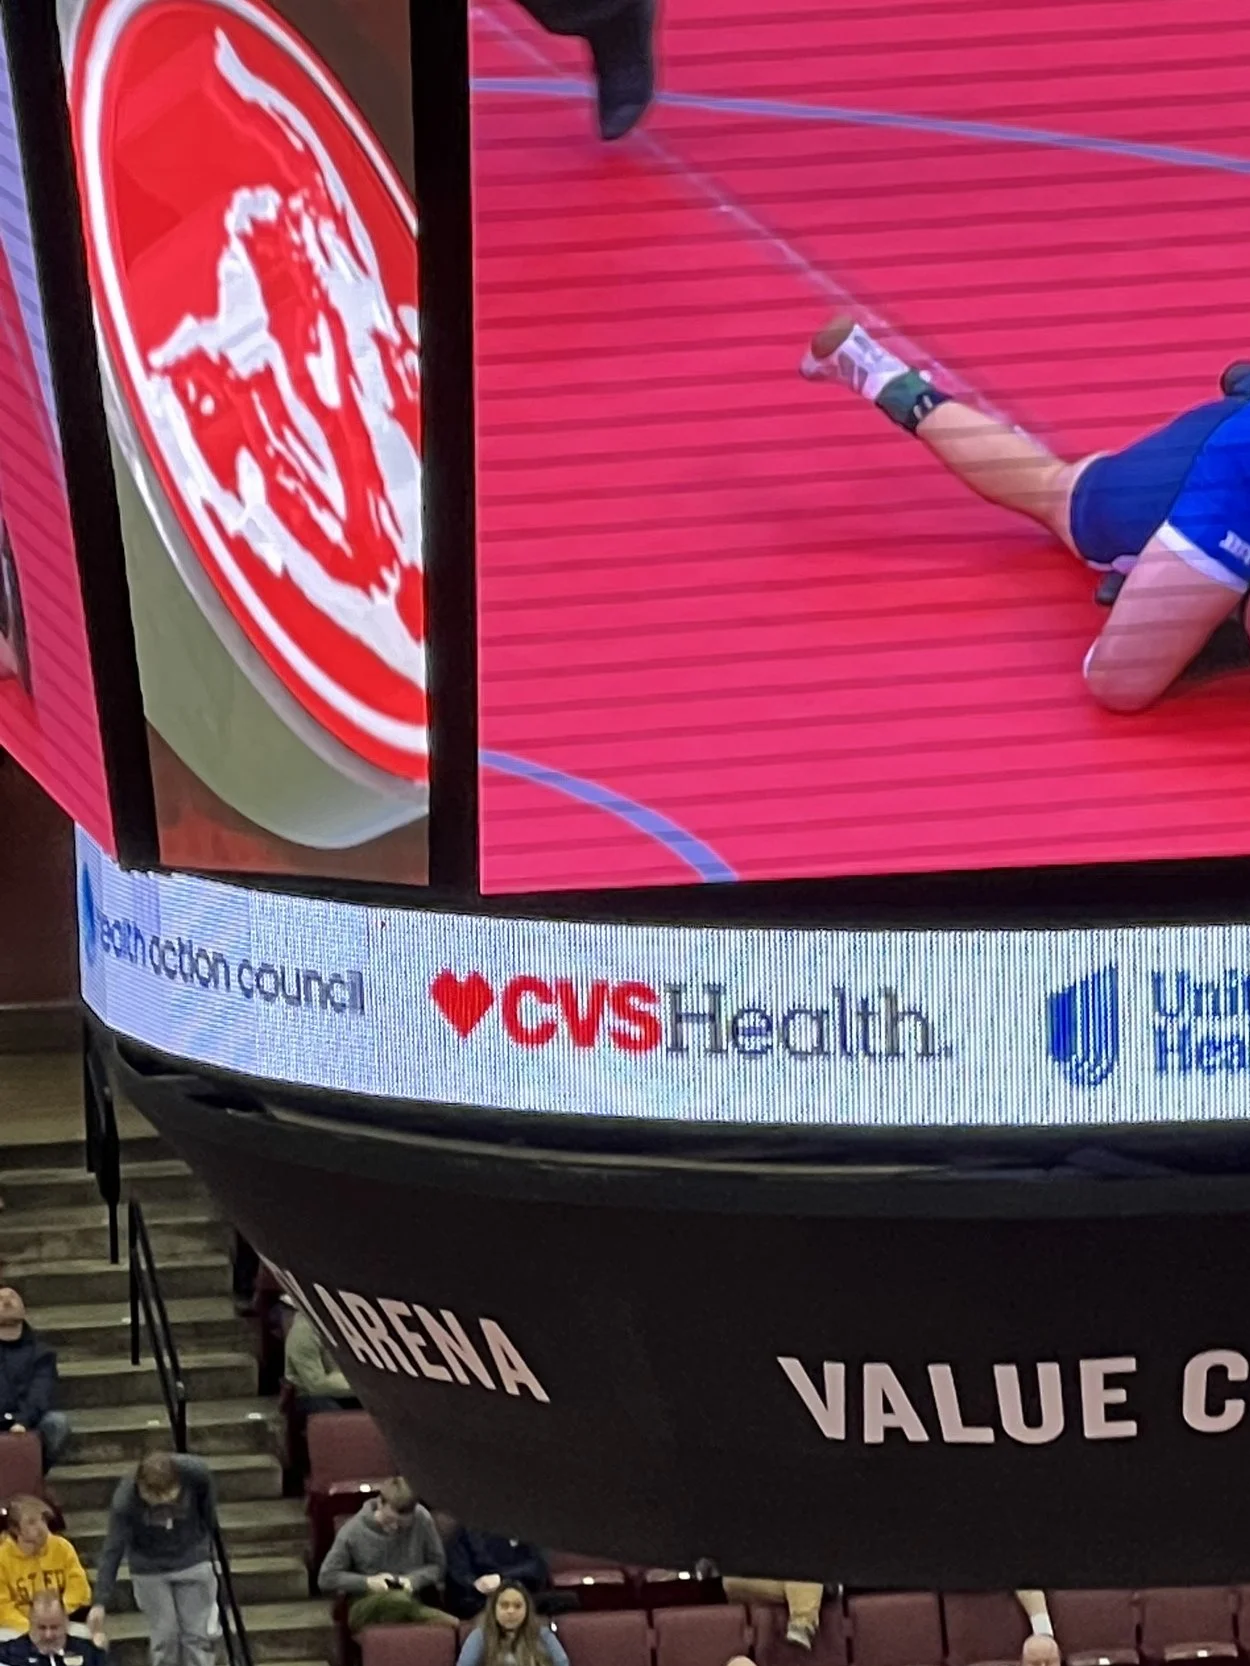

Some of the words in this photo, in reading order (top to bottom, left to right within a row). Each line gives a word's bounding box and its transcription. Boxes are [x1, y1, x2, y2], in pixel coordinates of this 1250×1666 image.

[237, 957, 365, 1014] council
[313, 1282, 551, 1403] ARENA
[777, 1355, 1138, 1445] VALUE
